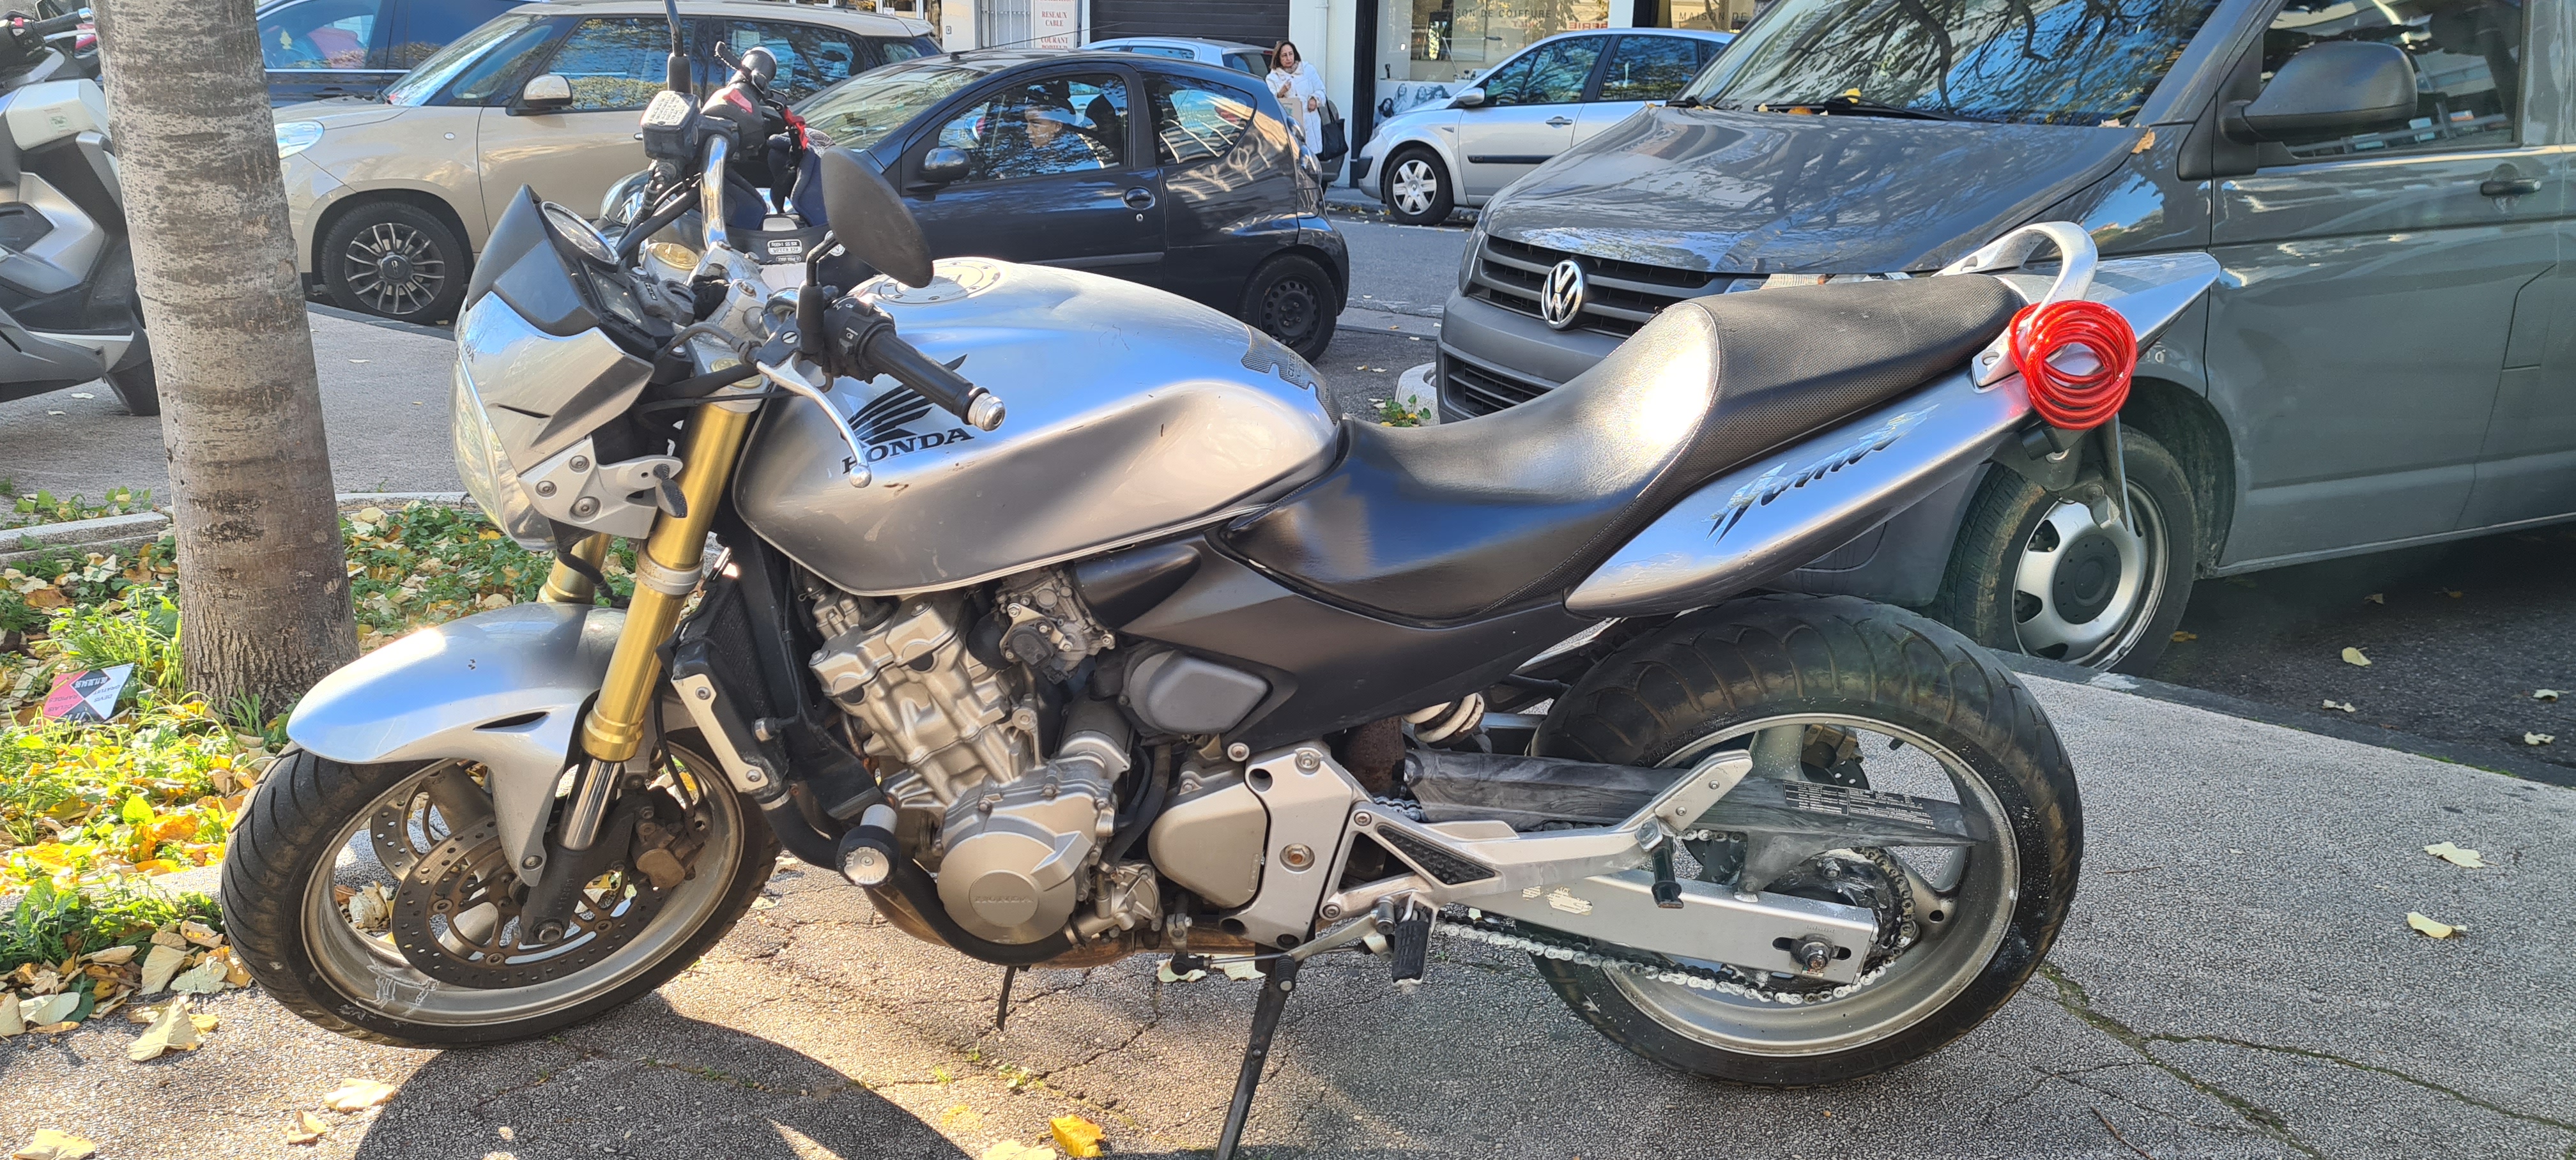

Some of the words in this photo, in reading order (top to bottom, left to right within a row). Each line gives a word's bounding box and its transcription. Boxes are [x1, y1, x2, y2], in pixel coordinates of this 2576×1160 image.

[1498, 9, 1551, 18] COIFFURE
[1679, 11, 1725, 20] MAISON
[1732, 11, 1747, 20] DE
[974, 894, 1034, 904] HONDA
